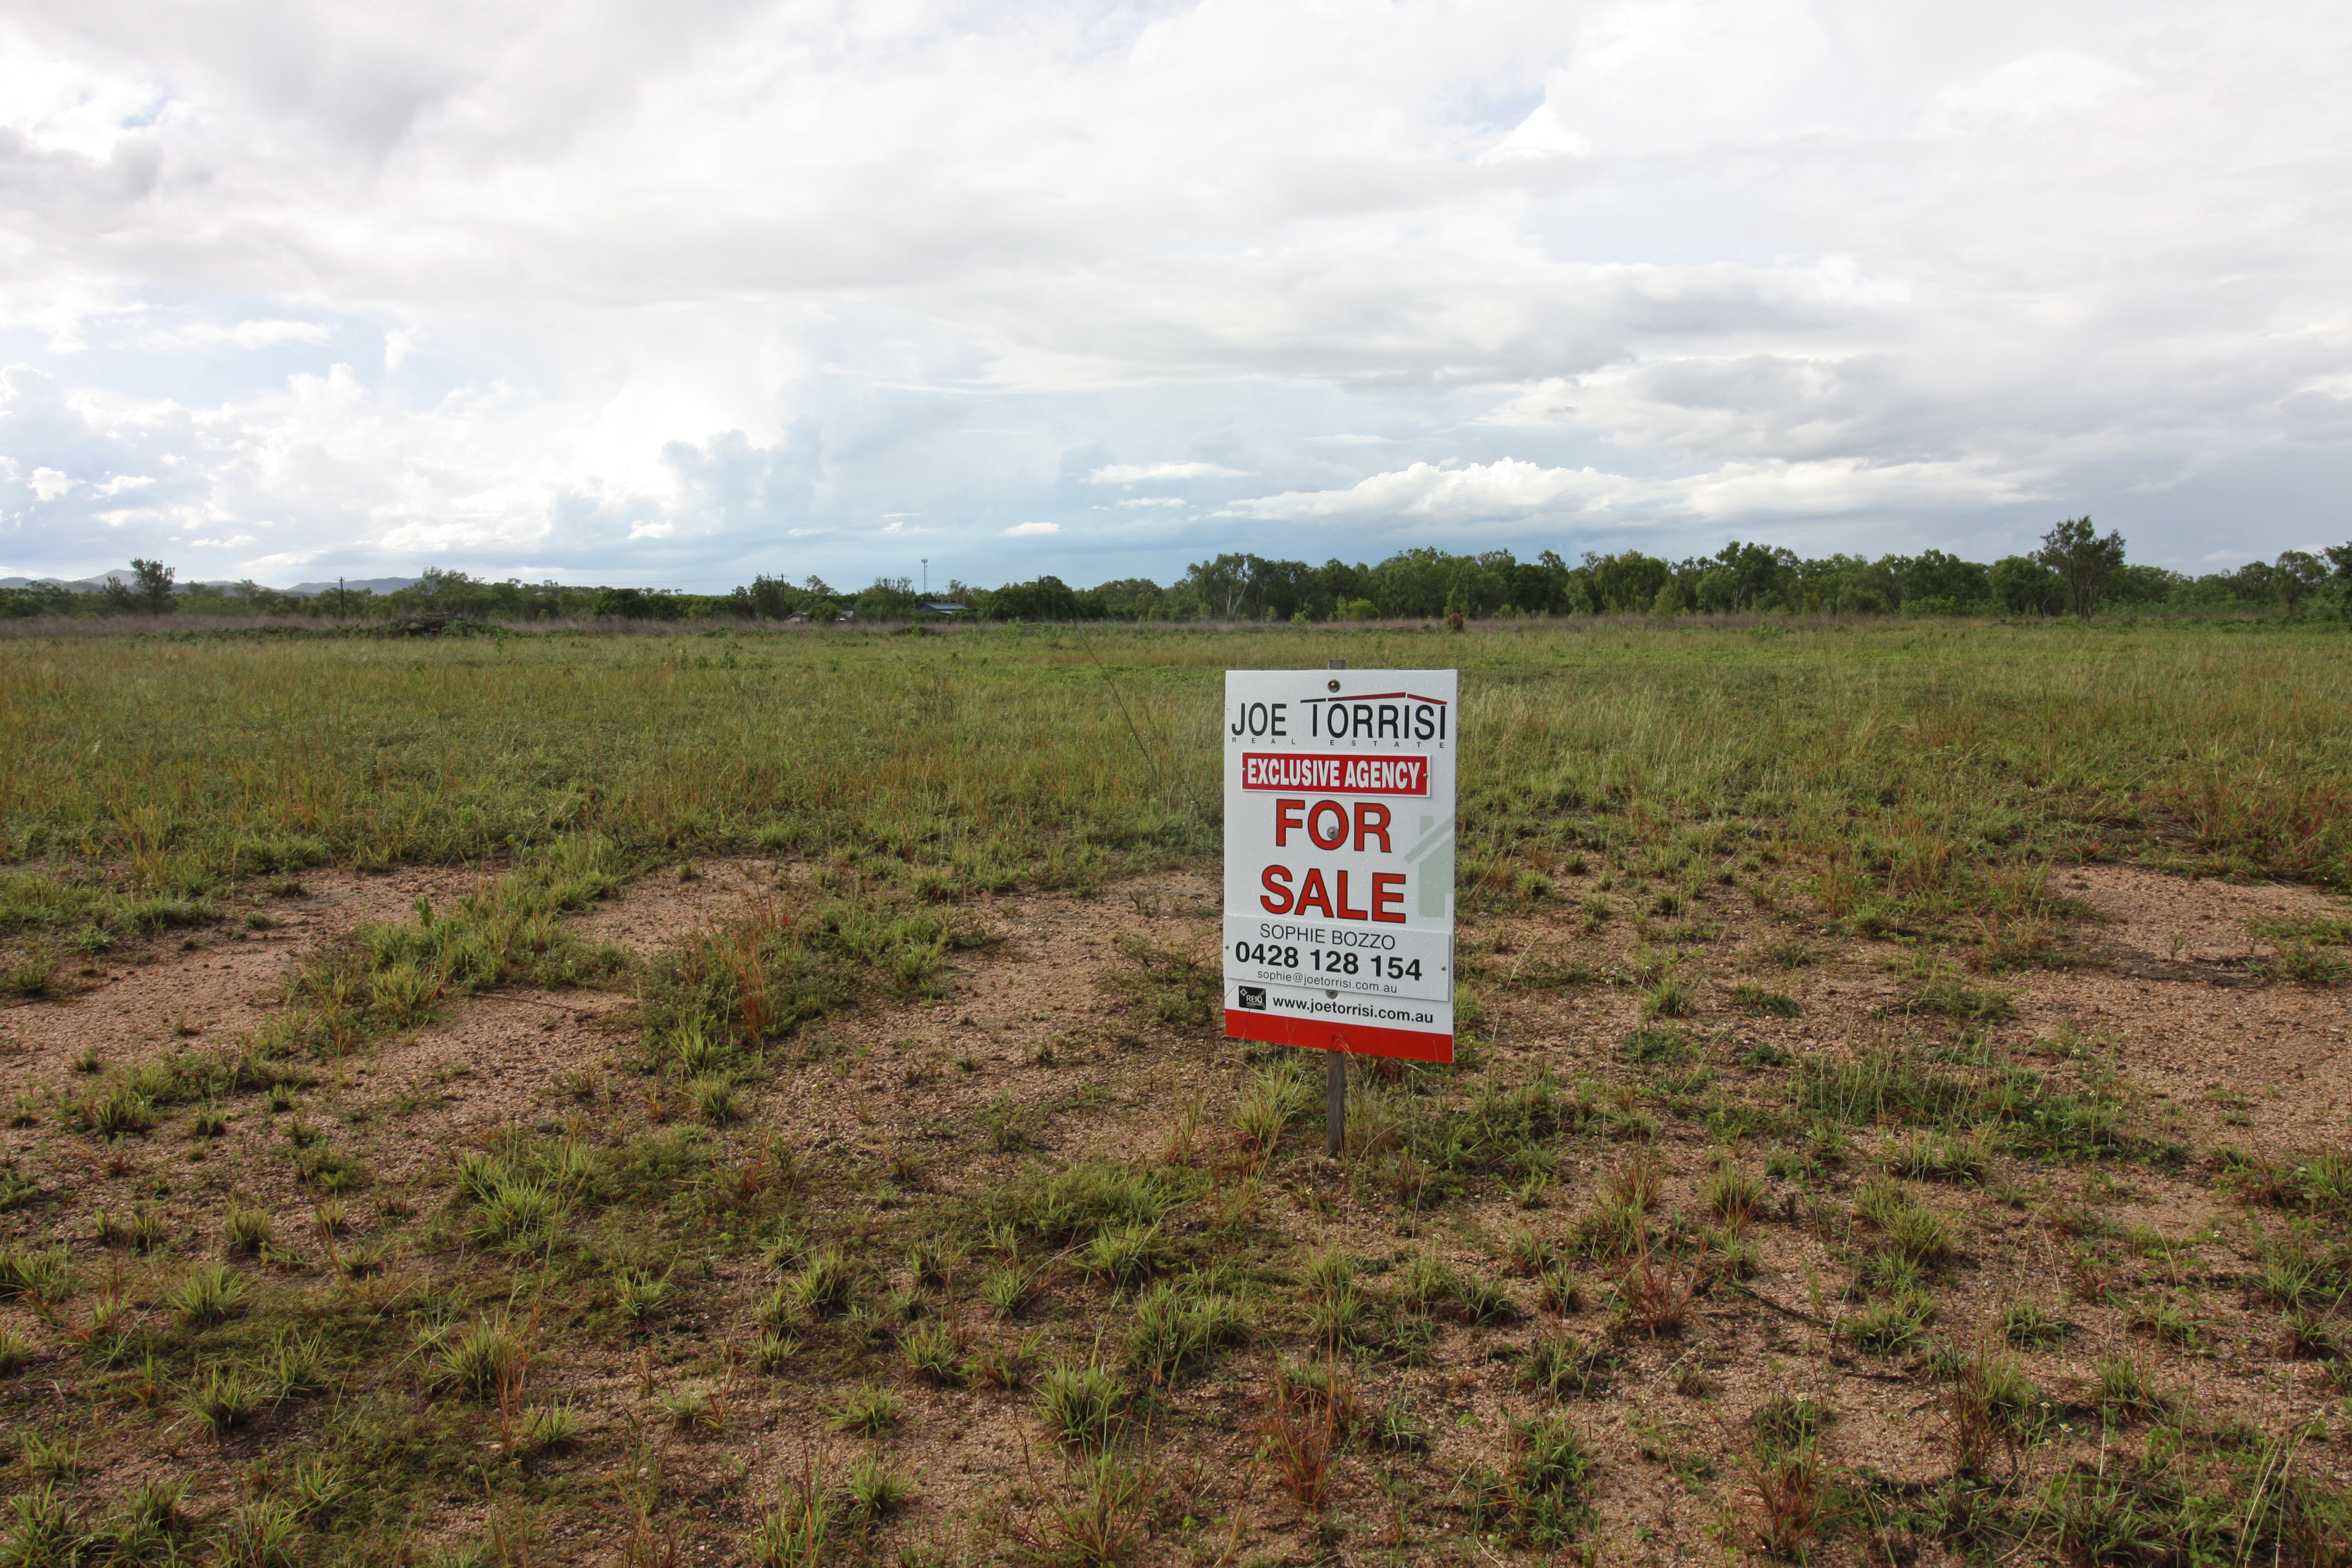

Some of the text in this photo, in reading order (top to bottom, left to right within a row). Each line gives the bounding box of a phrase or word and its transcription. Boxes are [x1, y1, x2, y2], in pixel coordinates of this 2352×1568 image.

[1232, 696, 1446, 740] JOE TORRISI
[1330, 739, 1444, 748] ESTATE
[1247, 758, 1421, 790] EXCLUSIVE AGENCY
[1276, 798, 1392, 853] FOR
[1260, 864, 1406, 924] SALE
[1260, 923, 1395, 950] SOPHIE BOZZO
[1235, 941, 1422, 981] 0428 128 154
[1257, 970, 1397, 994] sophie@joetorrisi.com.au
[1273, 997, 1434, 1023] www.joetorrisi.com.au
